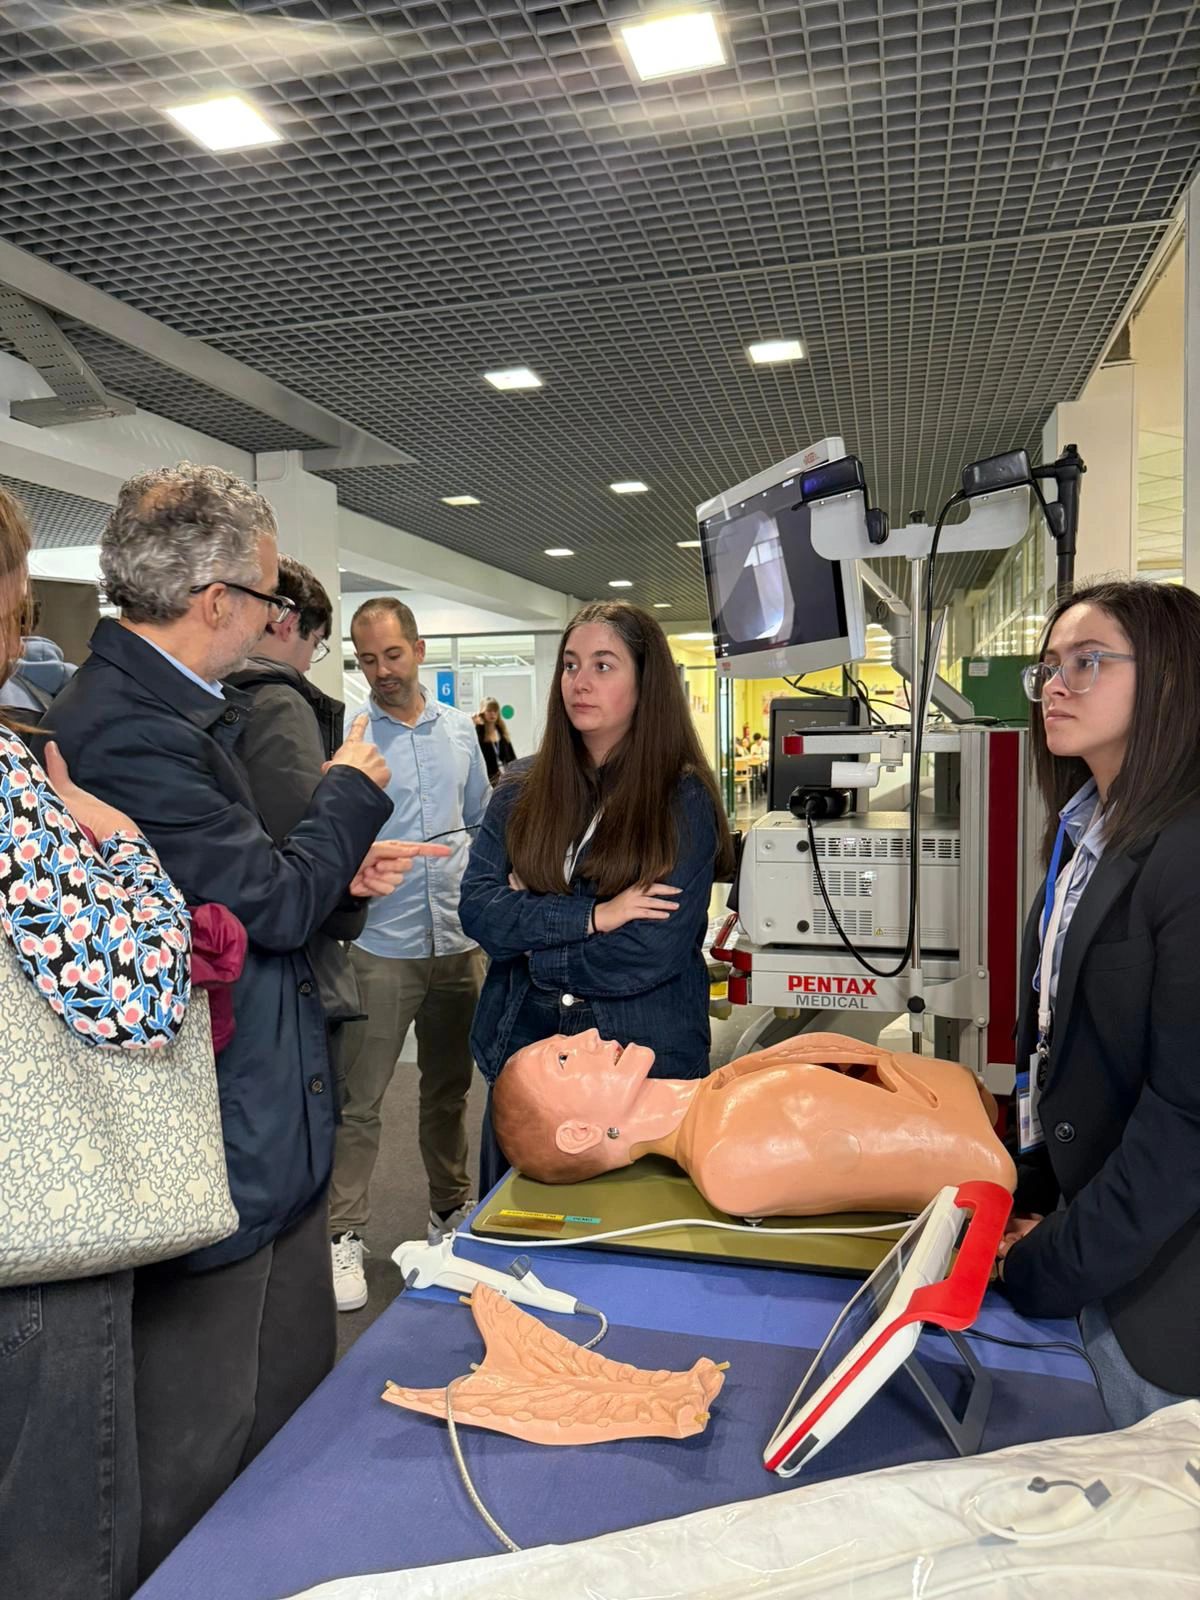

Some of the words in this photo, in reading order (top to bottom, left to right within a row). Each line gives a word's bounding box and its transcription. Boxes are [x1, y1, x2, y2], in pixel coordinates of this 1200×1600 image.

[442, 683, 451, 696] 6
[787, 975, 878, 995] PENTAX
[795, 994, 869, 1009] MEDICAL
